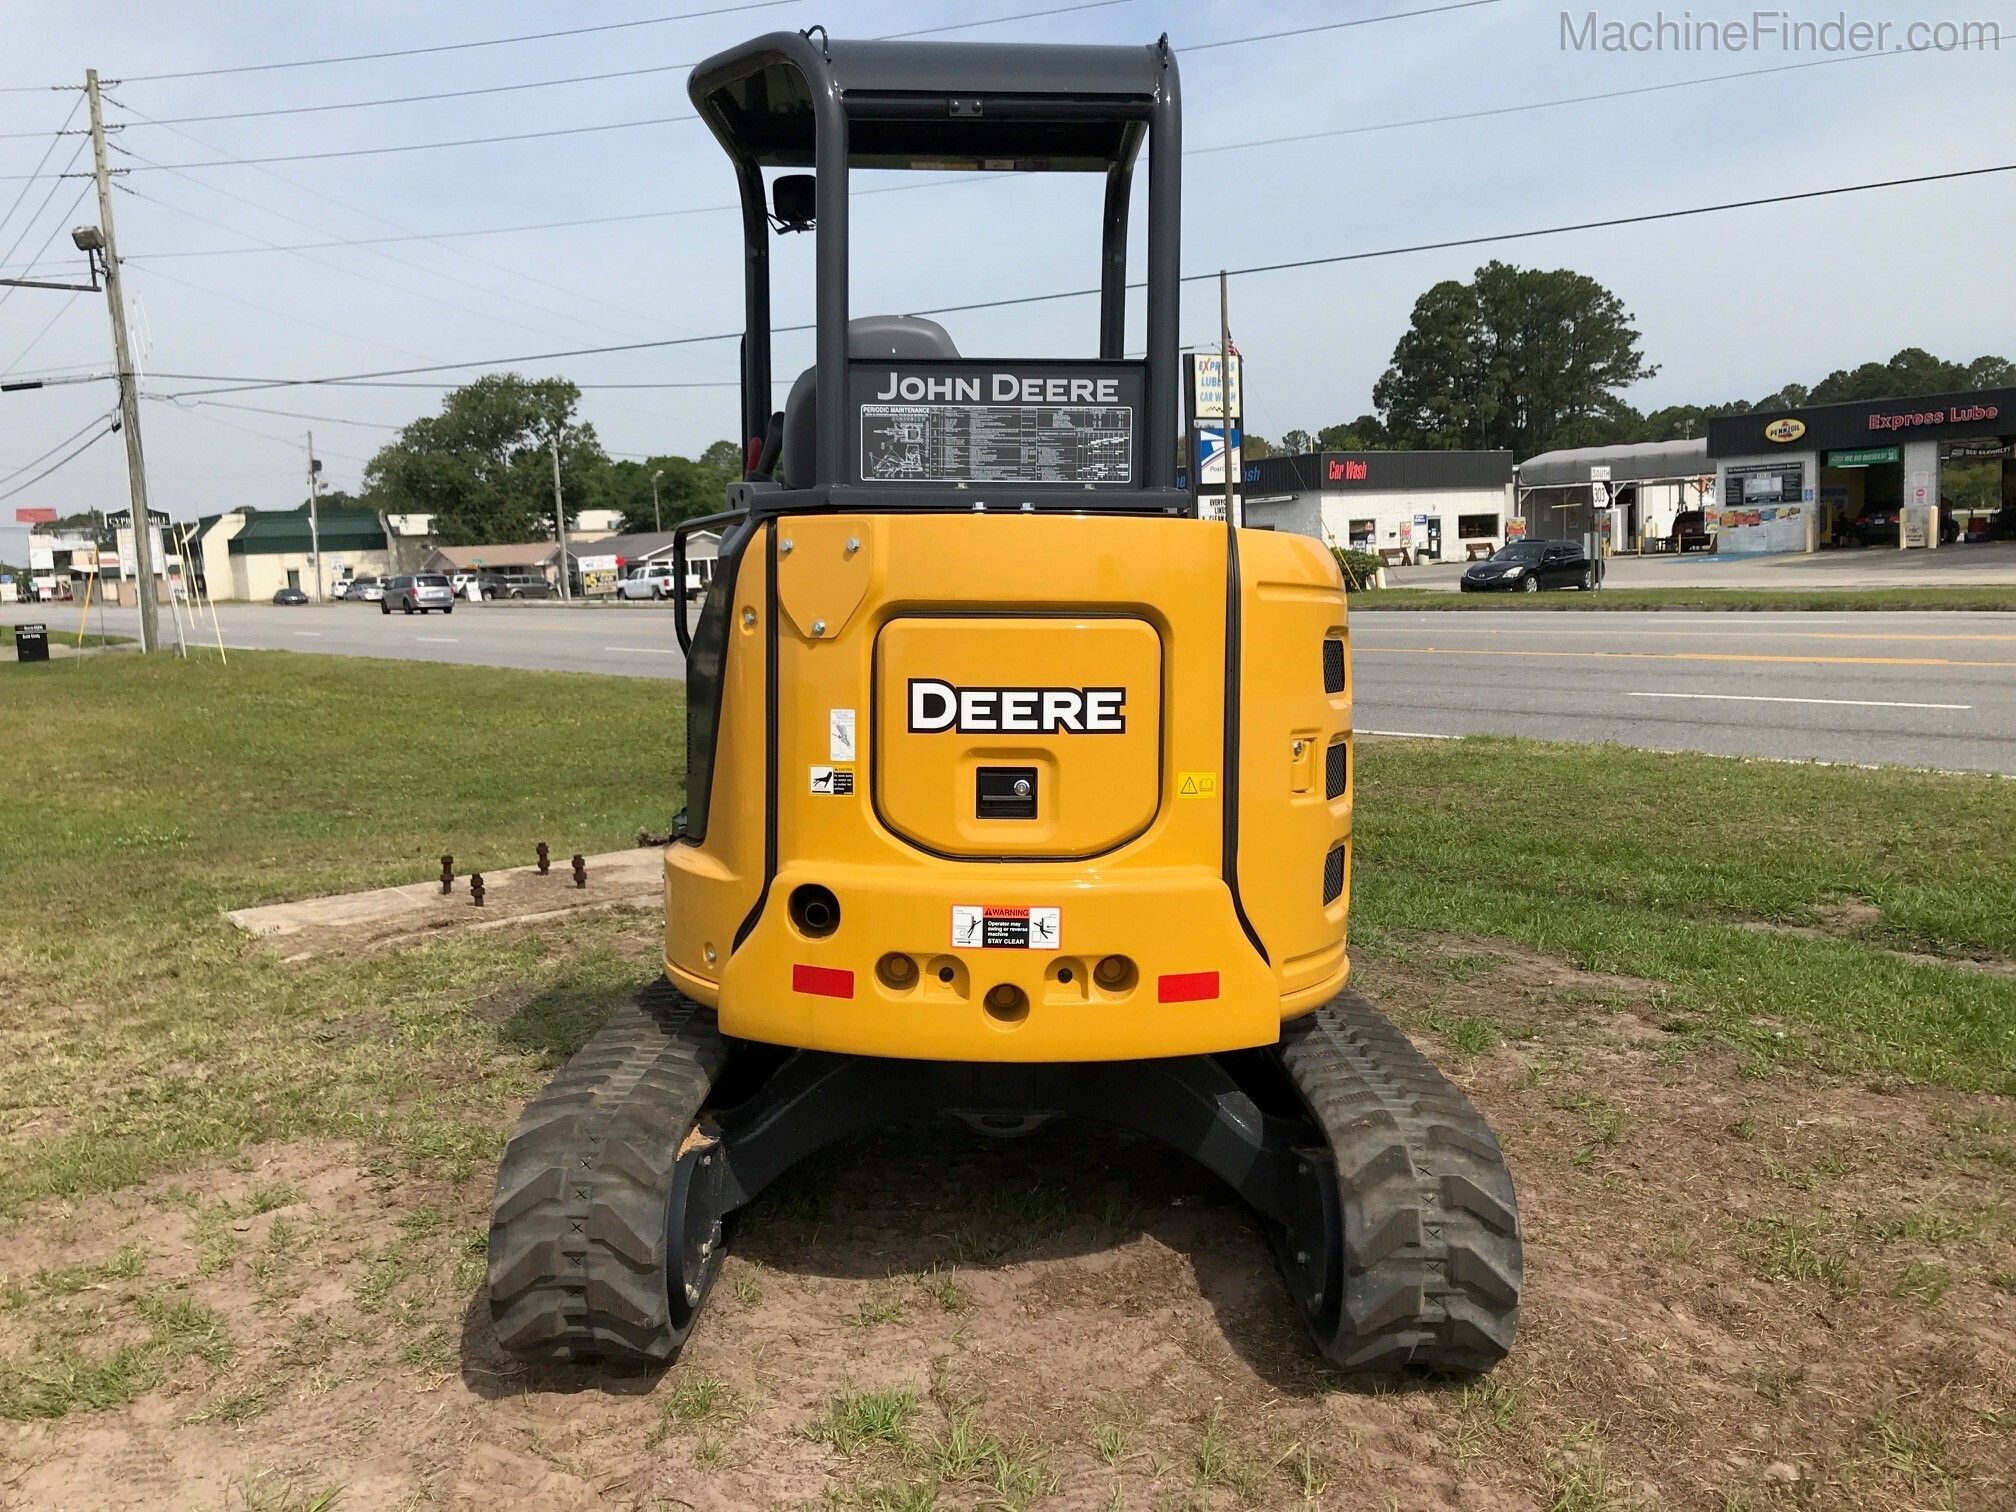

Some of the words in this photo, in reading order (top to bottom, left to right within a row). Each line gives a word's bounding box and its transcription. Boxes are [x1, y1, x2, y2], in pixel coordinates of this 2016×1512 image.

[1198, 358, 1235, 374] EXPRS
[877, 372, 980, 401] JOHN
[992, 373, 1119, 402] DEERE
[1200, 392, 1213, 402] CAR
[1215, 392, 1235, 402] WH
[1869, 410, 1944, 431] Express
[1950, 405, 1999, 423] Lube
[1769, 425, 1801, 437] PENNZOIL
[1329, 461, 1344, 479] Car
[1346, 461, 1367, 479] Wash
[1593, 469, 1610, 478] SOUTH
[1594, 487, 1605, 502] 303
[909, 678, 1125, 733] DEERE
